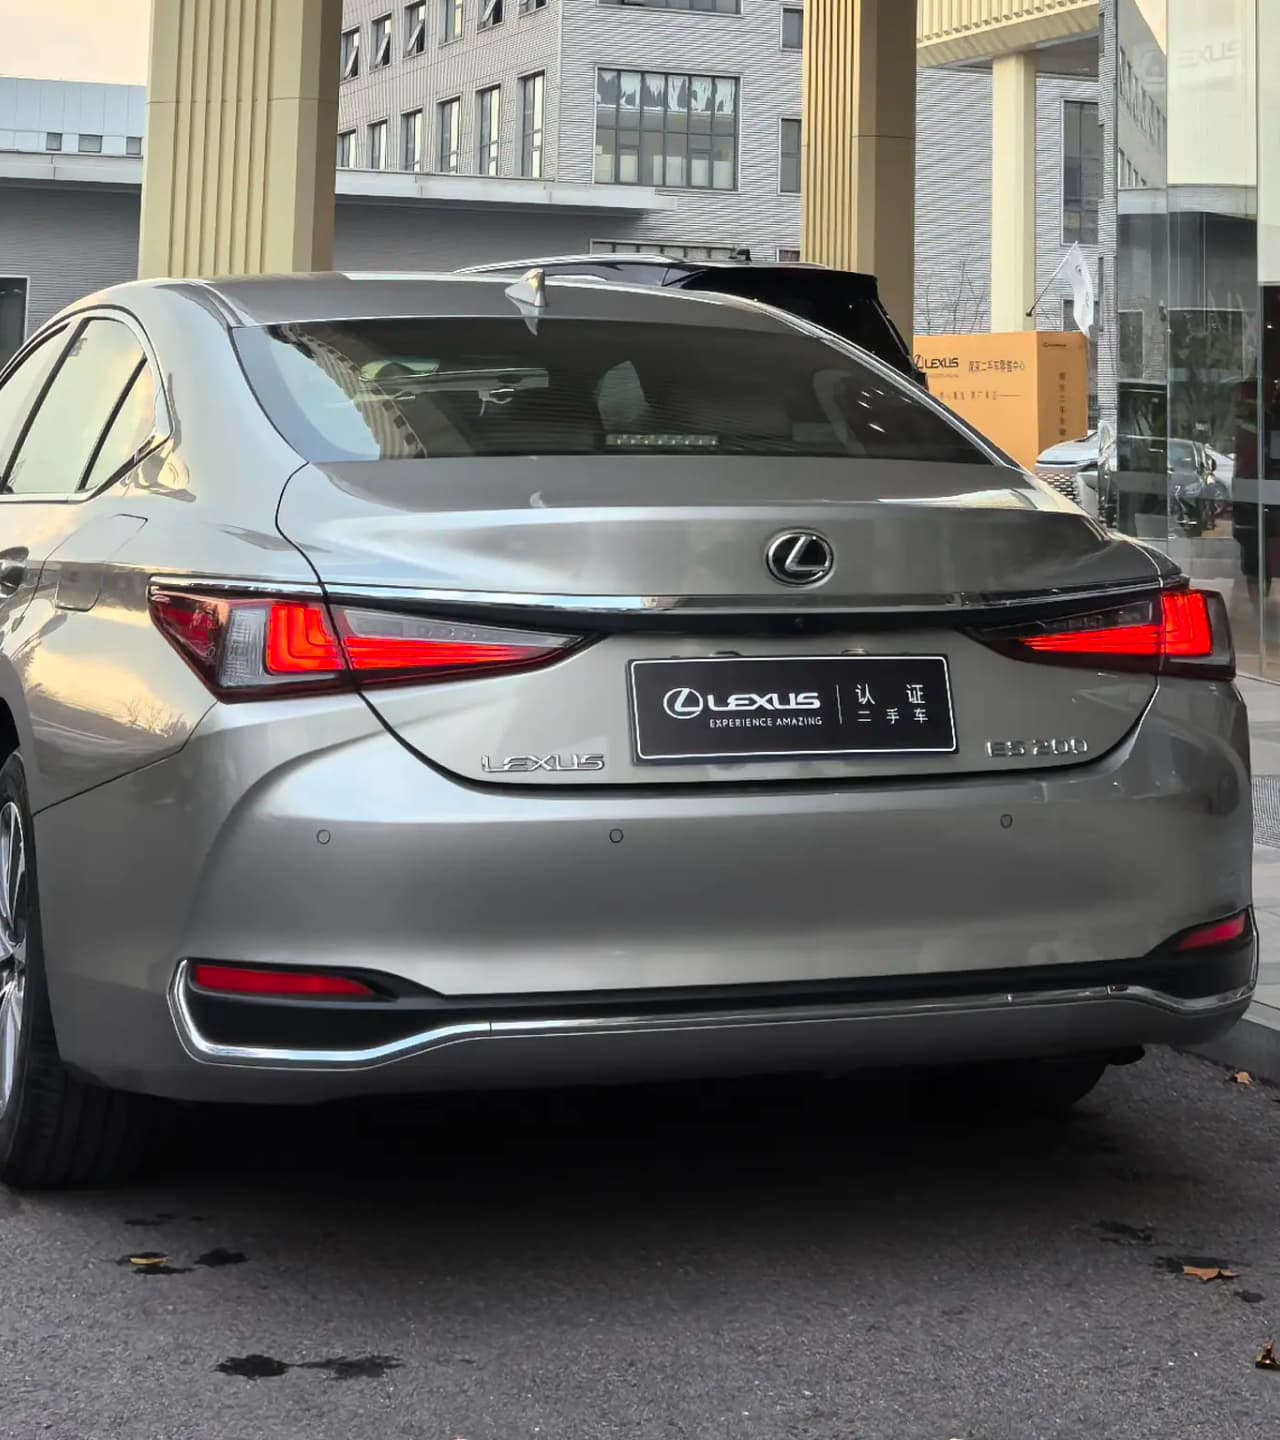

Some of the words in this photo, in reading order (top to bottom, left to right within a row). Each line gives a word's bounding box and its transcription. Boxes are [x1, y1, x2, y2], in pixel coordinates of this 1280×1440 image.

[925, 357, 959, 369] LEXUS
[708, 692, 820, 711] LEXUS
[856, 684, 927, 705] 认证
[709, 718, 773, 728] EXPERIENCE
[775, 716, 823, 727] AMAZING
[857, 707, 929, 725] 二手车
[986, 739, 1024, 758] ES
[1031, 737, 1088, 756] 200
[481, 754, 605, 773] LEXUS
